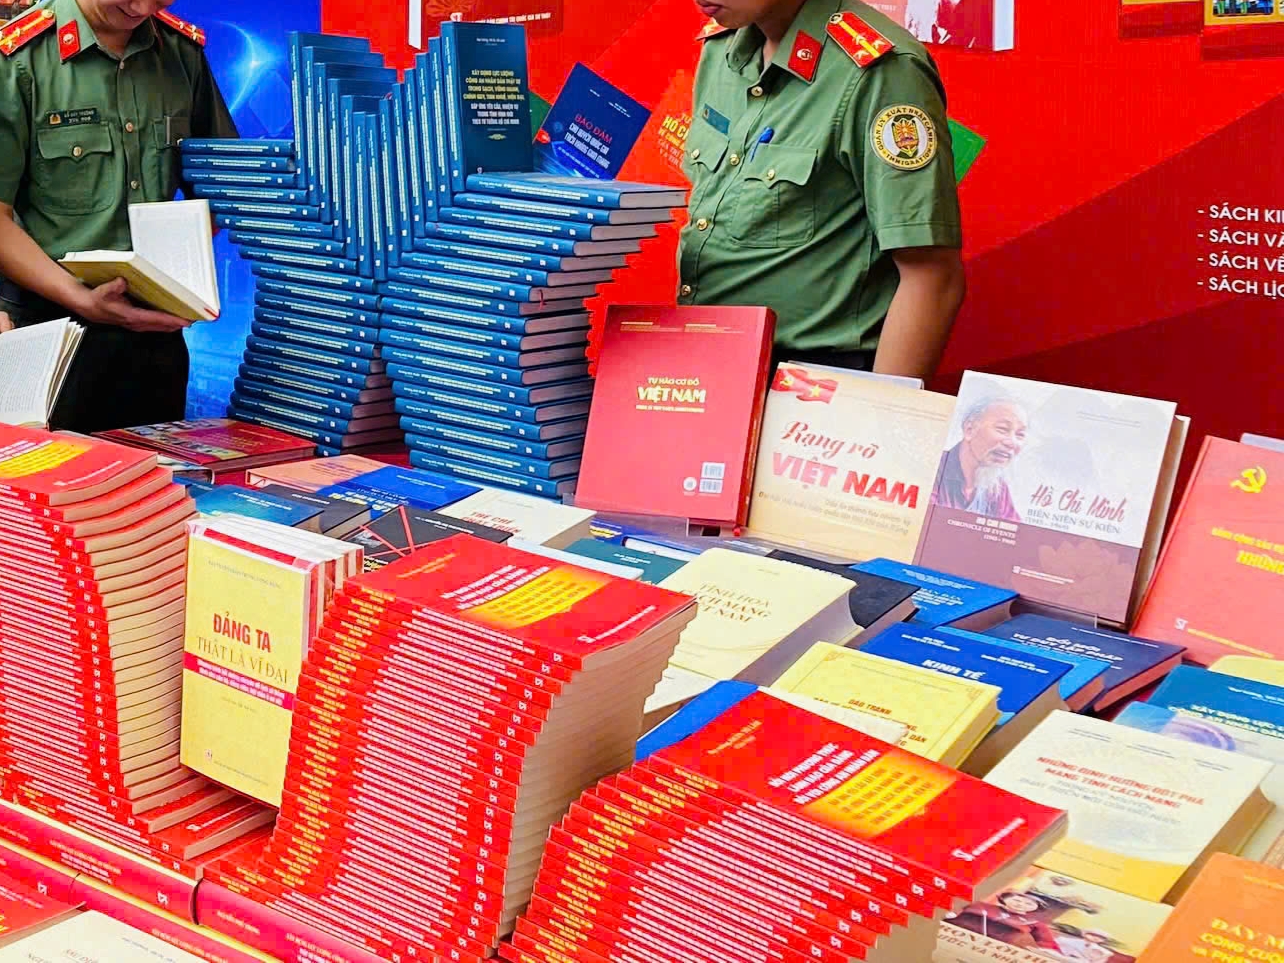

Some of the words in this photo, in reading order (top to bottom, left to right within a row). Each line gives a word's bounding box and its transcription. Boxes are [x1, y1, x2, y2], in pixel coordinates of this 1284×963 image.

[886, 148, 933, 165] IMMIGRATION
[1209, 202, 1259, 222] SÁCH
[1209, 226, 1259, 246] SÁCH
[1209, 250, 1259, 270] SÁCH
[1209, 274, 1258, 294] SÁCH
[637, 385, 670, 404] VIỆT
[671, 388, 706, 404] NAM
[781, 420, 845, 459] Rạng
[772, 452, 838, 489] VIỆT
[842, 470, 919, 509] NAM
[1031, 484, 1053, 507] Hồ
[1058, 488, 1083, 512] Chí
[1087, 494, 1126, 523] Minh
[213, 611, 251, 646] ĐẢNG
[255, 628, 272, 653] TA
[197, 635, 229, 661] THẬT
[230, 648, 245, 665] LÀ
[266, 665, 289, 686] ĐẠI
[921, 658, 960, 676] KINH
[962, 668, 987, 681] TẾ
